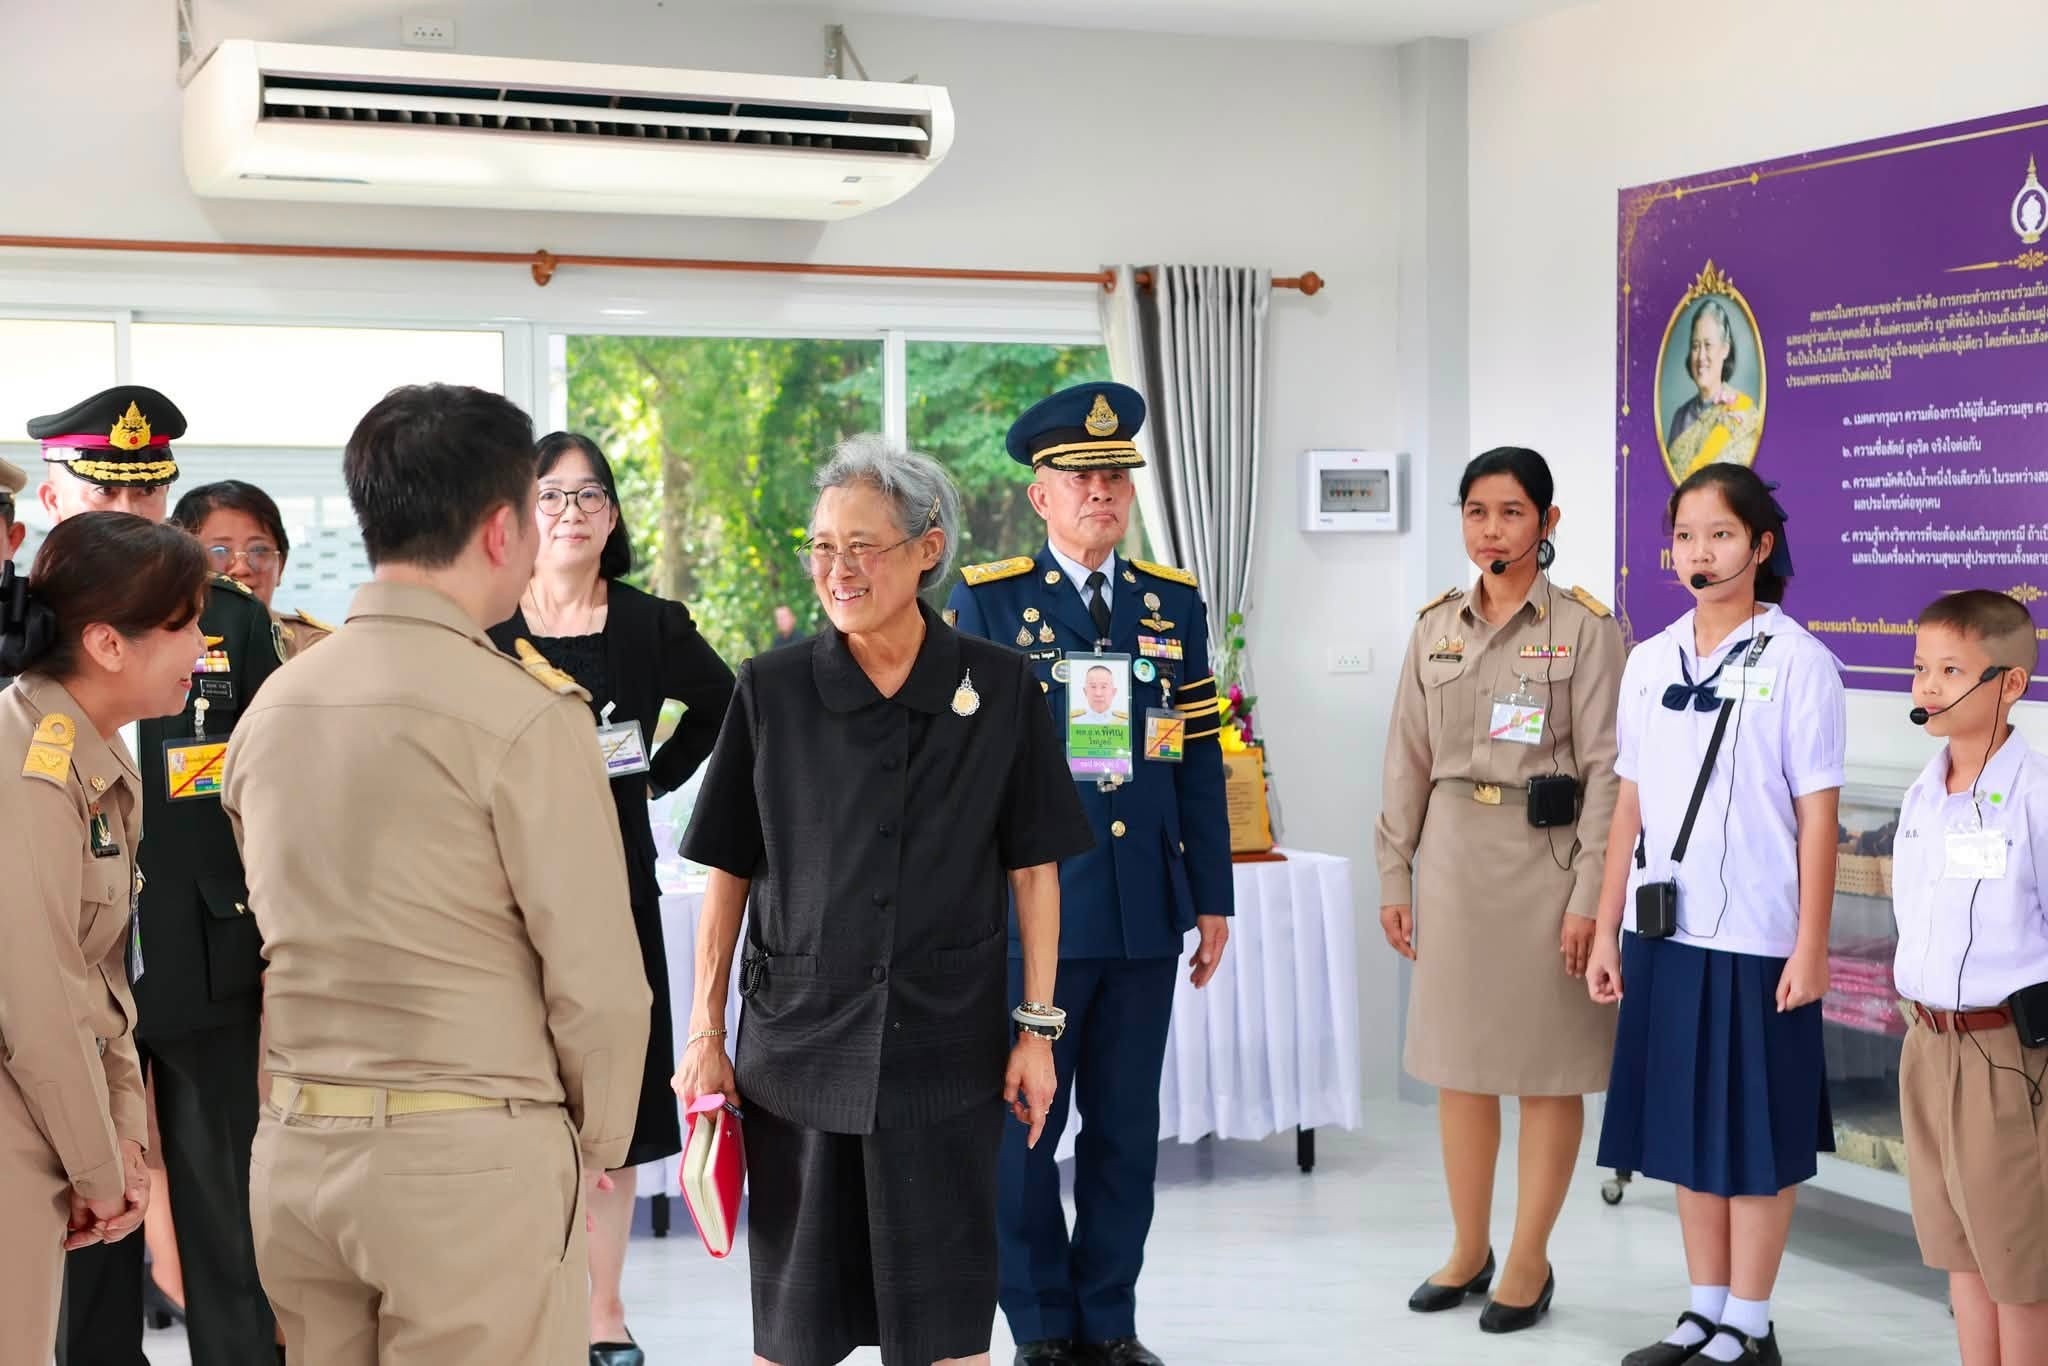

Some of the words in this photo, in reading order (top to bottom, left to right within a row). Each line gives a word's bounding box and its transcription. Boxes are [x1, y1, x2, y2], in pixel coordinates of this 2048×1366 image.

[1935, 302, 2048, 332] ญาติพี่น้องไปจนถึงเพื่อนฝู
[1854, 411, 1903, 428] เมตตากรุณา
[1904, 397, 2034, 423] ความต้องการให้ผู้อื่นมีความสุข
[1853, 436, 1905, 457] ความซื่อสัตย์
[1906, 438, 1930, 459] สุจริต
[1931, 435, 1982, 454] จริงใจต่อกัน
[1853, 465, 1991, 489] ความสามัคคีเป็นน้ำหนึ่งใจเดียวกัน
[1854, 494, 1941, 514] ผลประโยชน์ต่อทุกคน
[1852, 521, 2025, 547] ความรู้ทางวิชาการที่จะต้องส่งเสริมทุกกรณี
